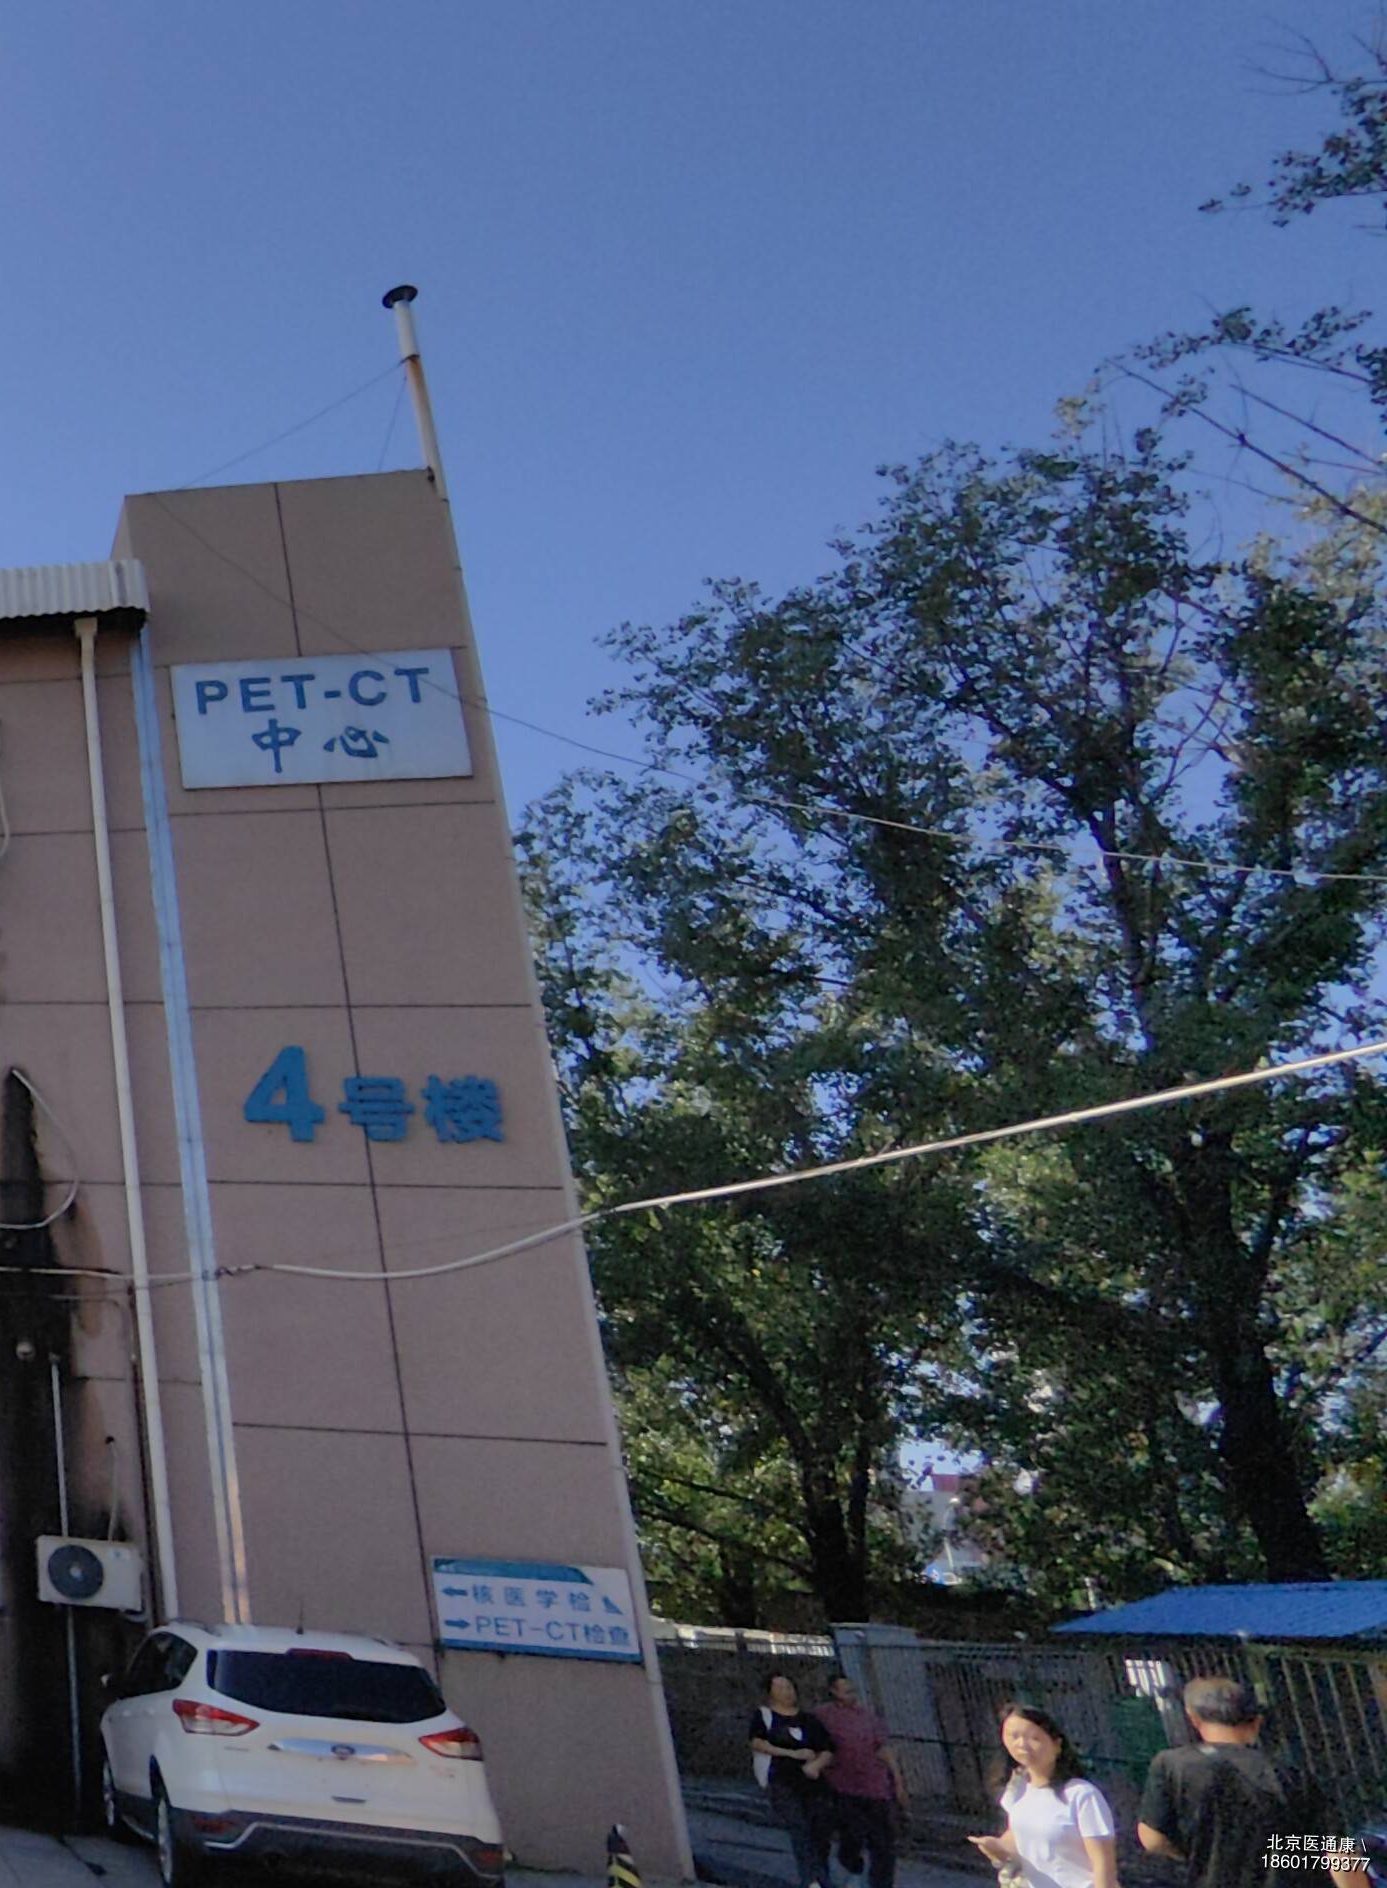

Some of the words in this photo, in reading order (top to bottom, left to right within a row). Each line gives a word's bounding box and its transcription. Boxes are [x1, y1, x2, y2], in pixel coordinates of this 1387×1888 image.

[195, 666, 430, 715] PET-CT
[251, 718, 390, 773] 中心
[243, 1045, 505, 1144] 4号楼
